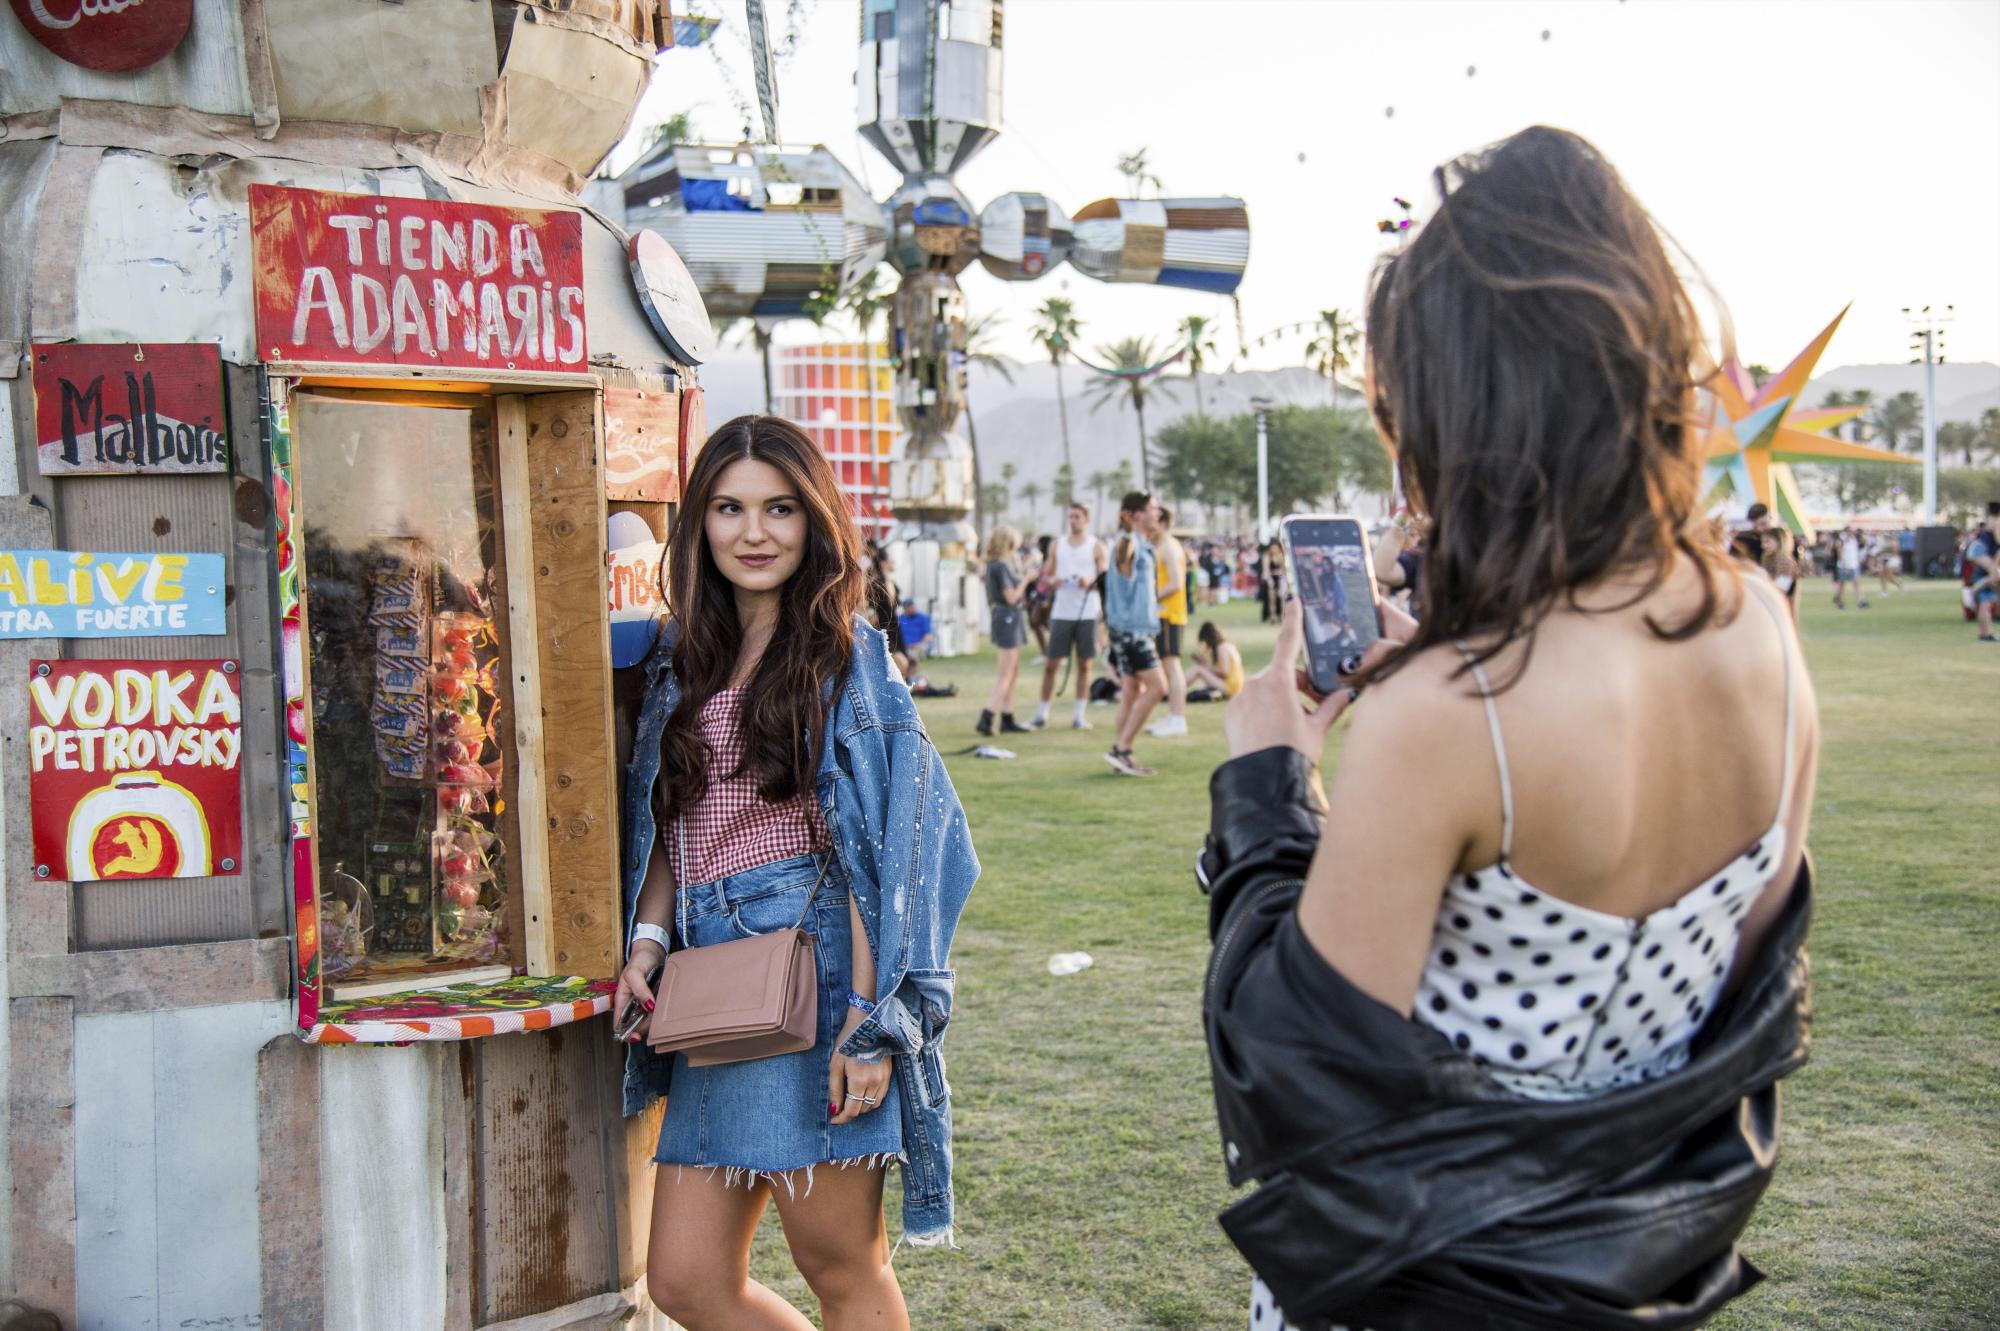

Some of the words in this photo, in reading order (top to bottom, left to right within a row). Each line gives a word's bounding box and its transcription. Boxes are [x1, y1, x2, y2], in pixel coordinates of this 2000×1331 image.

[57, 370, 229, 467] Malboris
[0, 608, 54, 632] TRA
[76, 603, 189, 631] FUERTE
[30, 669, 241, 729] VODKA
[30, 725, 241, 772] PETROVSKY
